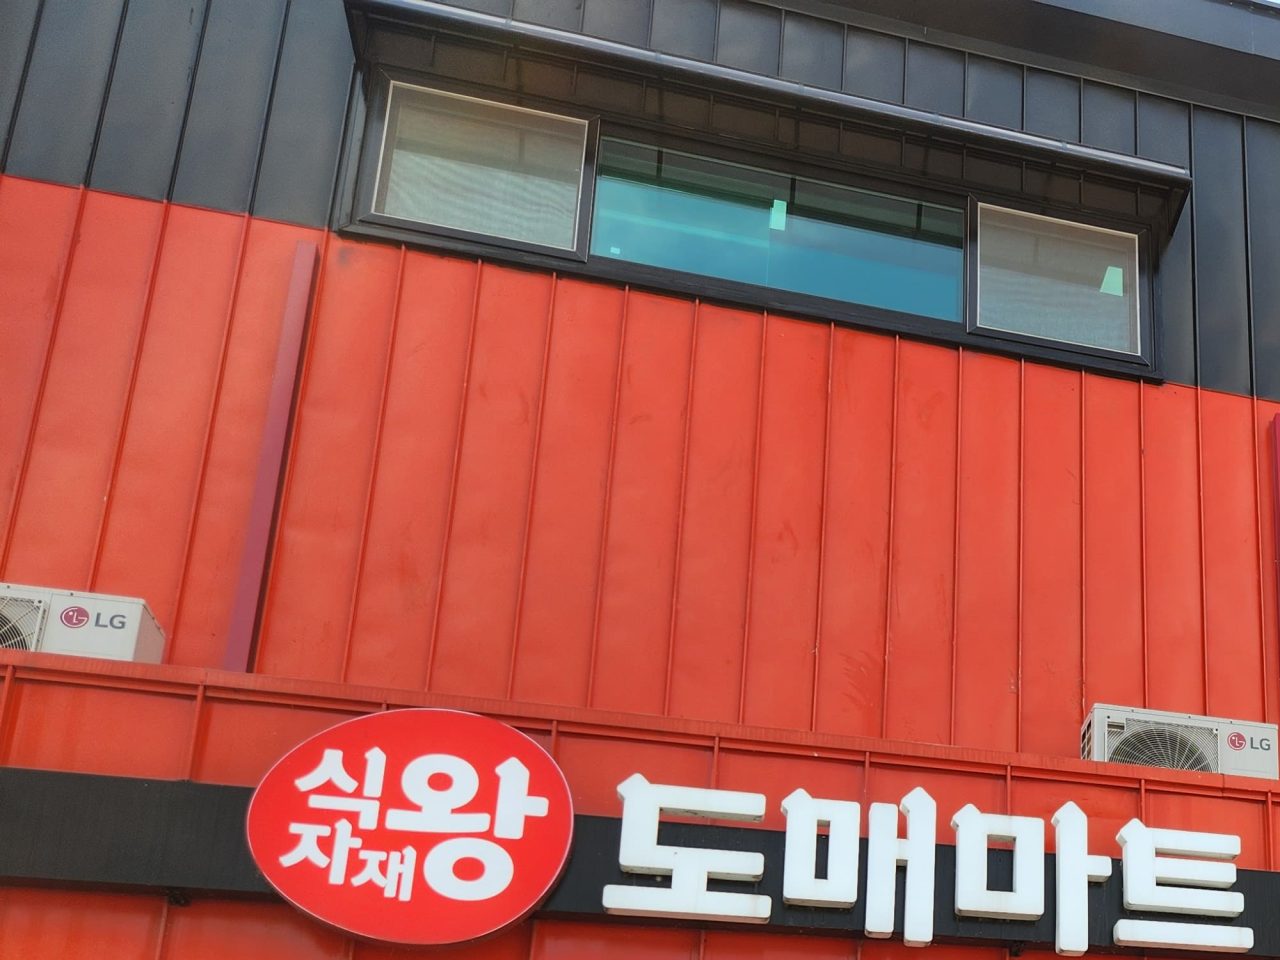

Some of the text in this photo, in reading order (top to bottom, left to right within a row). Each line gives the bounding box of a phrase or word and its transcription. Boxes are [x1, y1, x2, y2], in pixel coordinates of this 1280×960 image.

[95, 612, 127, 630] LG
[1250, 736, 1271, 751] LG
[602, 772, 1254, 957] 도매마트
